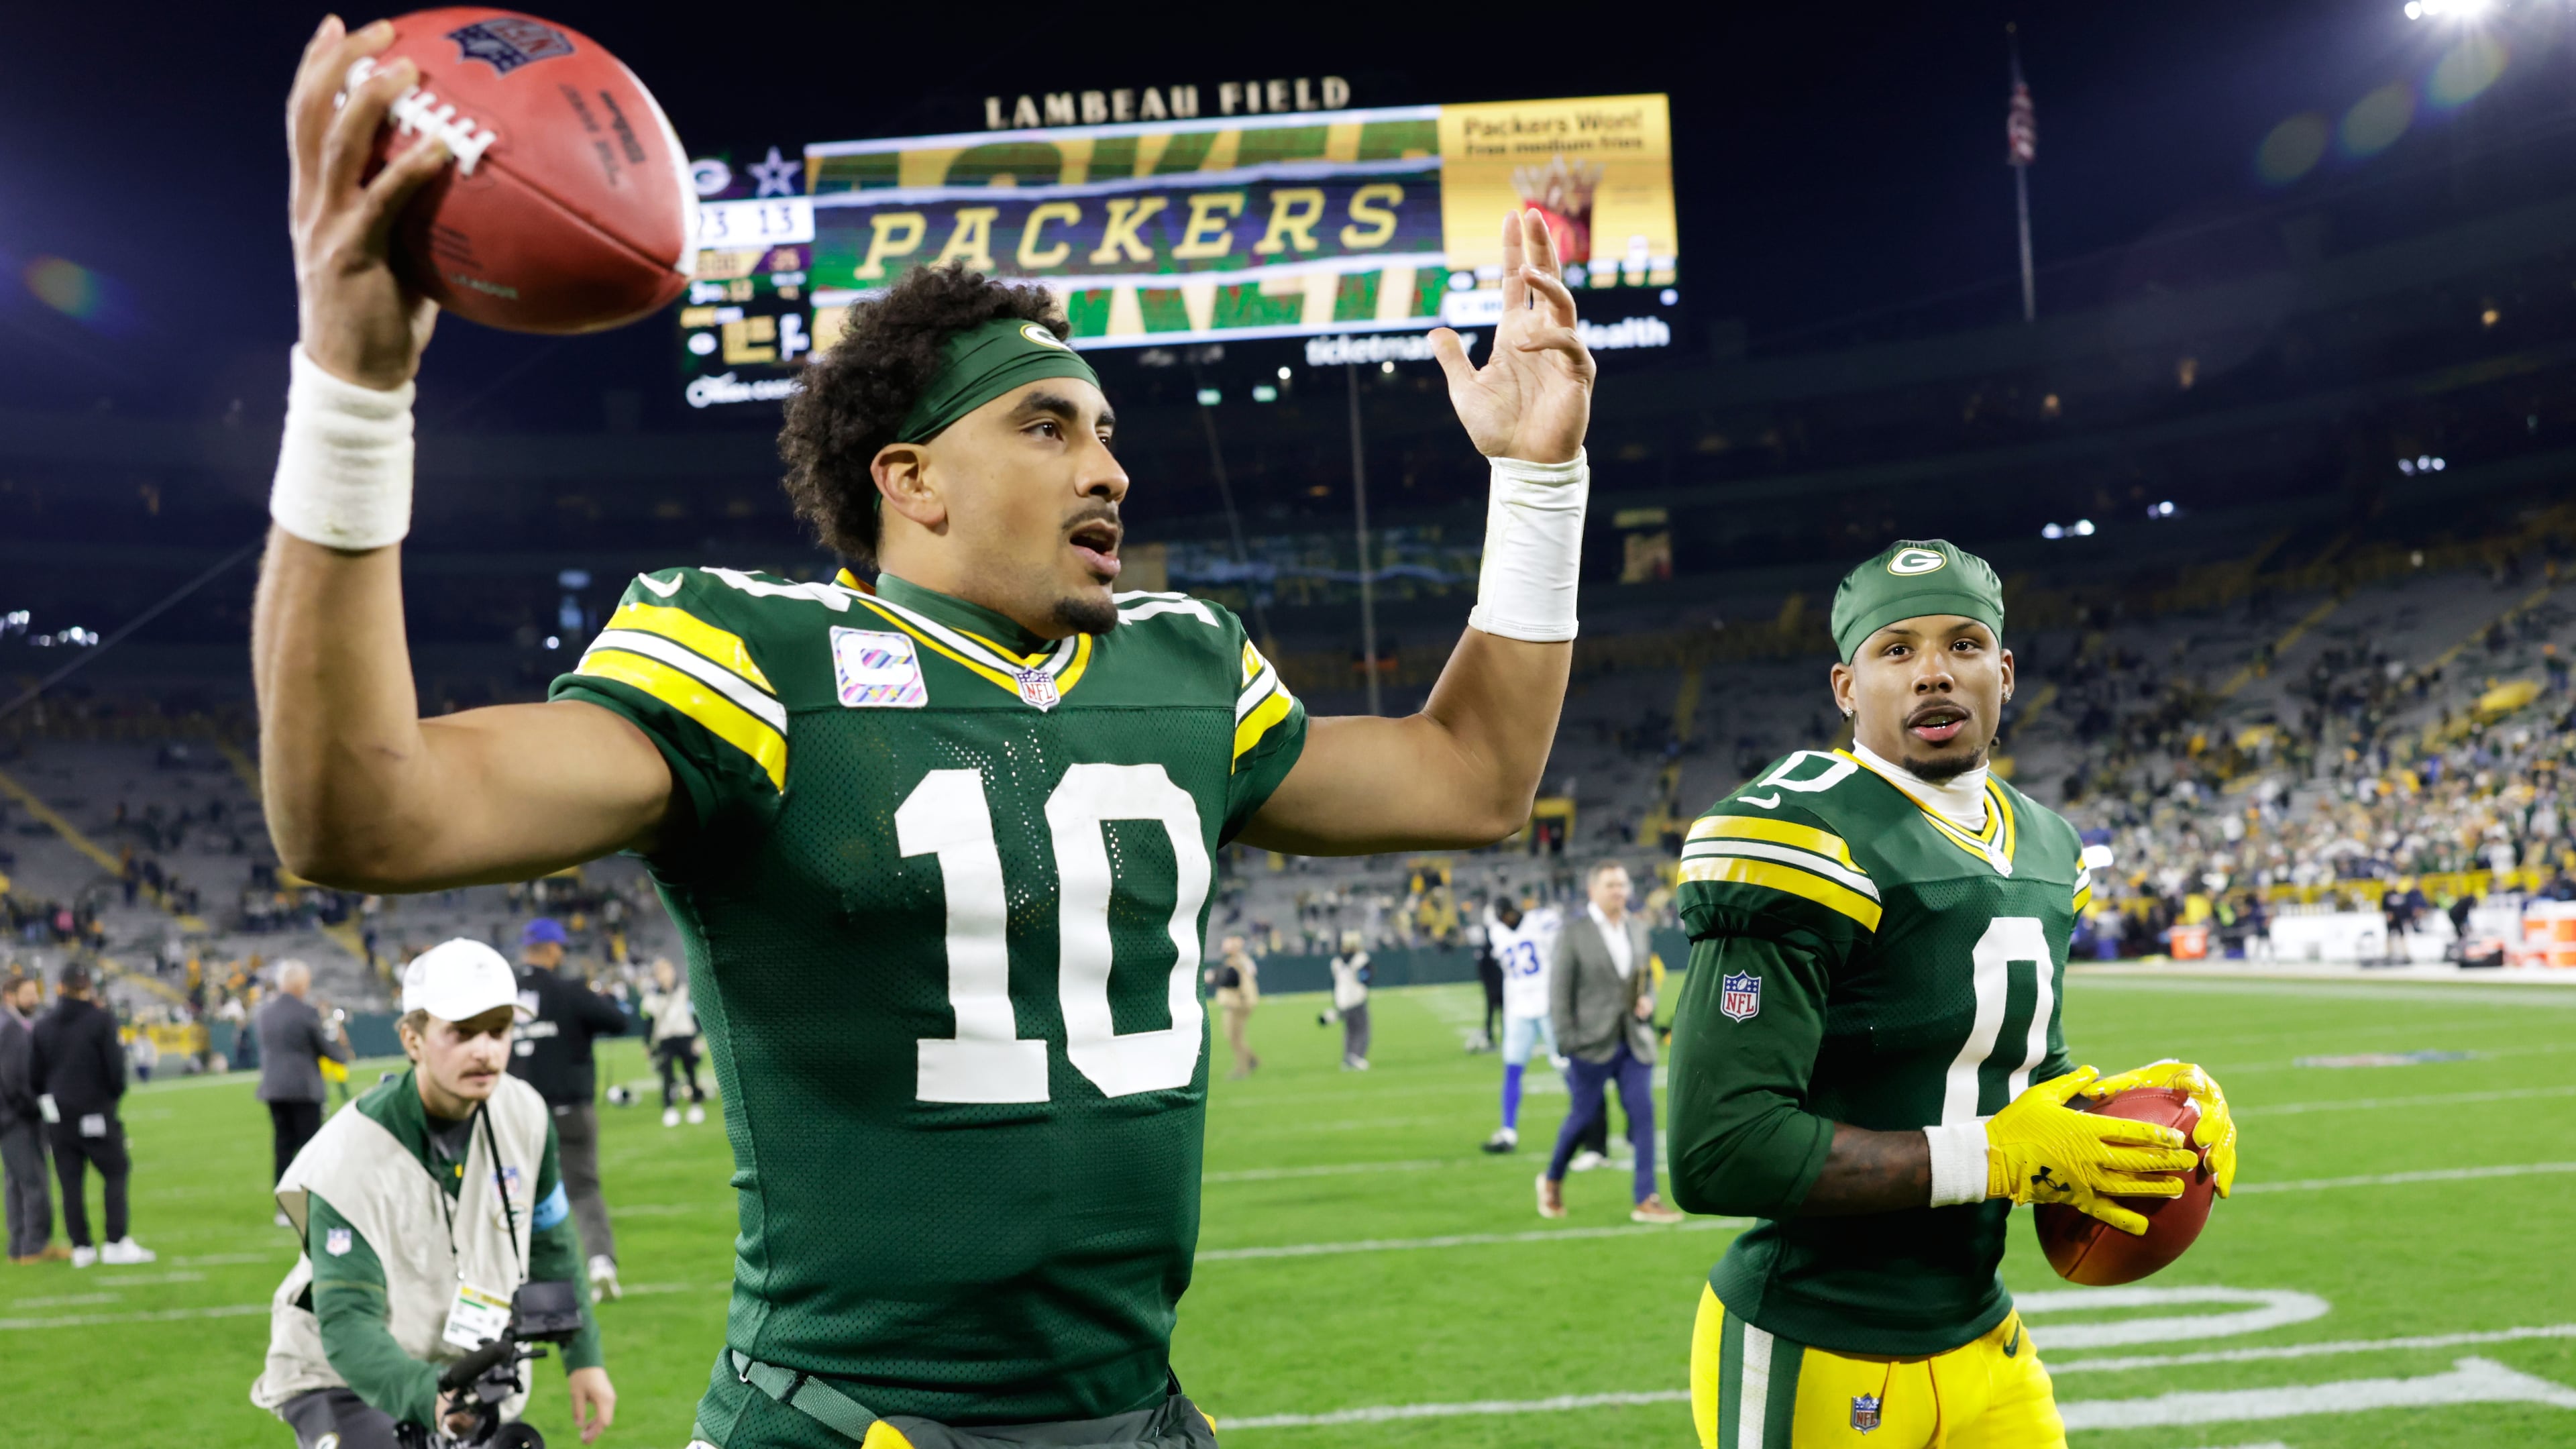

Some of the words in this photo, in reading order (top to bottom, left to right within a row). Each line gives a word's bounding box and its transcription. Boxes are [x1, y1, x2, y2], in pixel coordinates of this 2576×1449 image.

[985, 83, 1199, 131] LAMBEAU
[1218, 75, 1351, 116] FIELD
[759, 206, 794, 233] 13
[854, 182, 1404, 279] PACKERS
[1890, 549, 1943, 574] G
[839, 634, 916, 686] C
[1025, 683, 1053, 702] NFL
[894, 763, 1211, 1102] 10
[1725, 992, 1755, 1015] NFL
[1941, 916, 2054, 1128] 0
[1856, 1411, 1878, 1427] NFL
